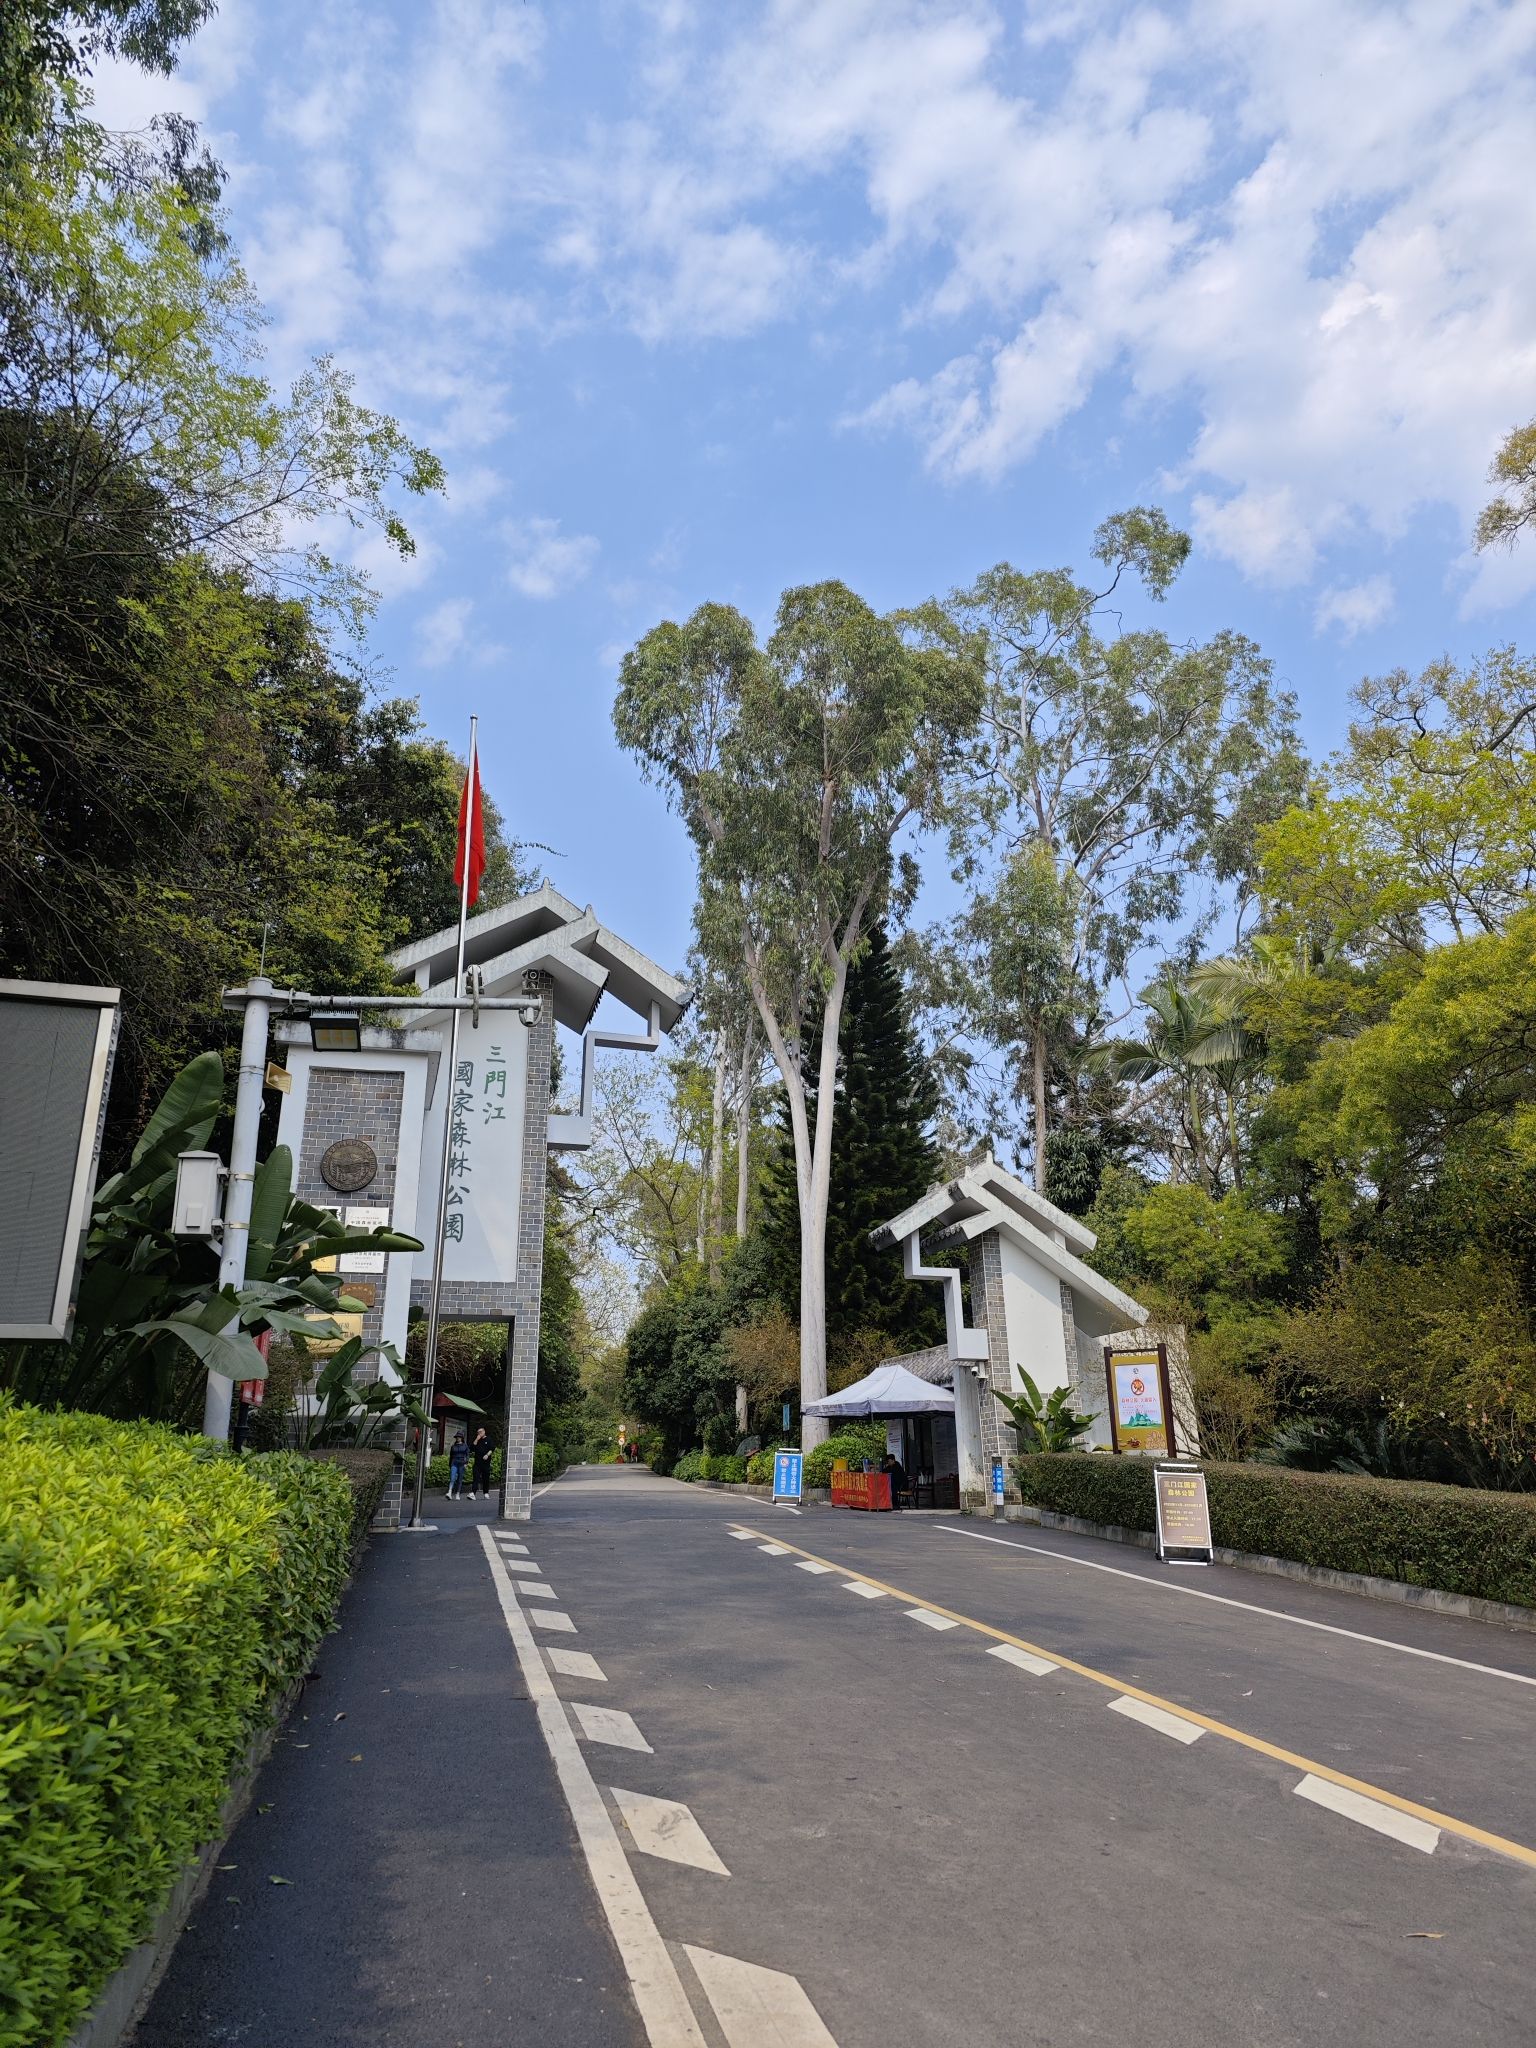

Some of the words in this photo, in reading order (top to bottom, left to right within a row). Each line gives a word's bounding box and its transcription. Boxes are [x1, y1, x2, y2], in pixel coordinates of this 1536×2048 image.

[482, 1045, 507, 1125] 三門江
[444, 1060, 475, 1243] 國家森林公園
[1163, 1480, 1198, 1489] 三门江国家
[1167, 1488, 1195, 1497] 森林公园
